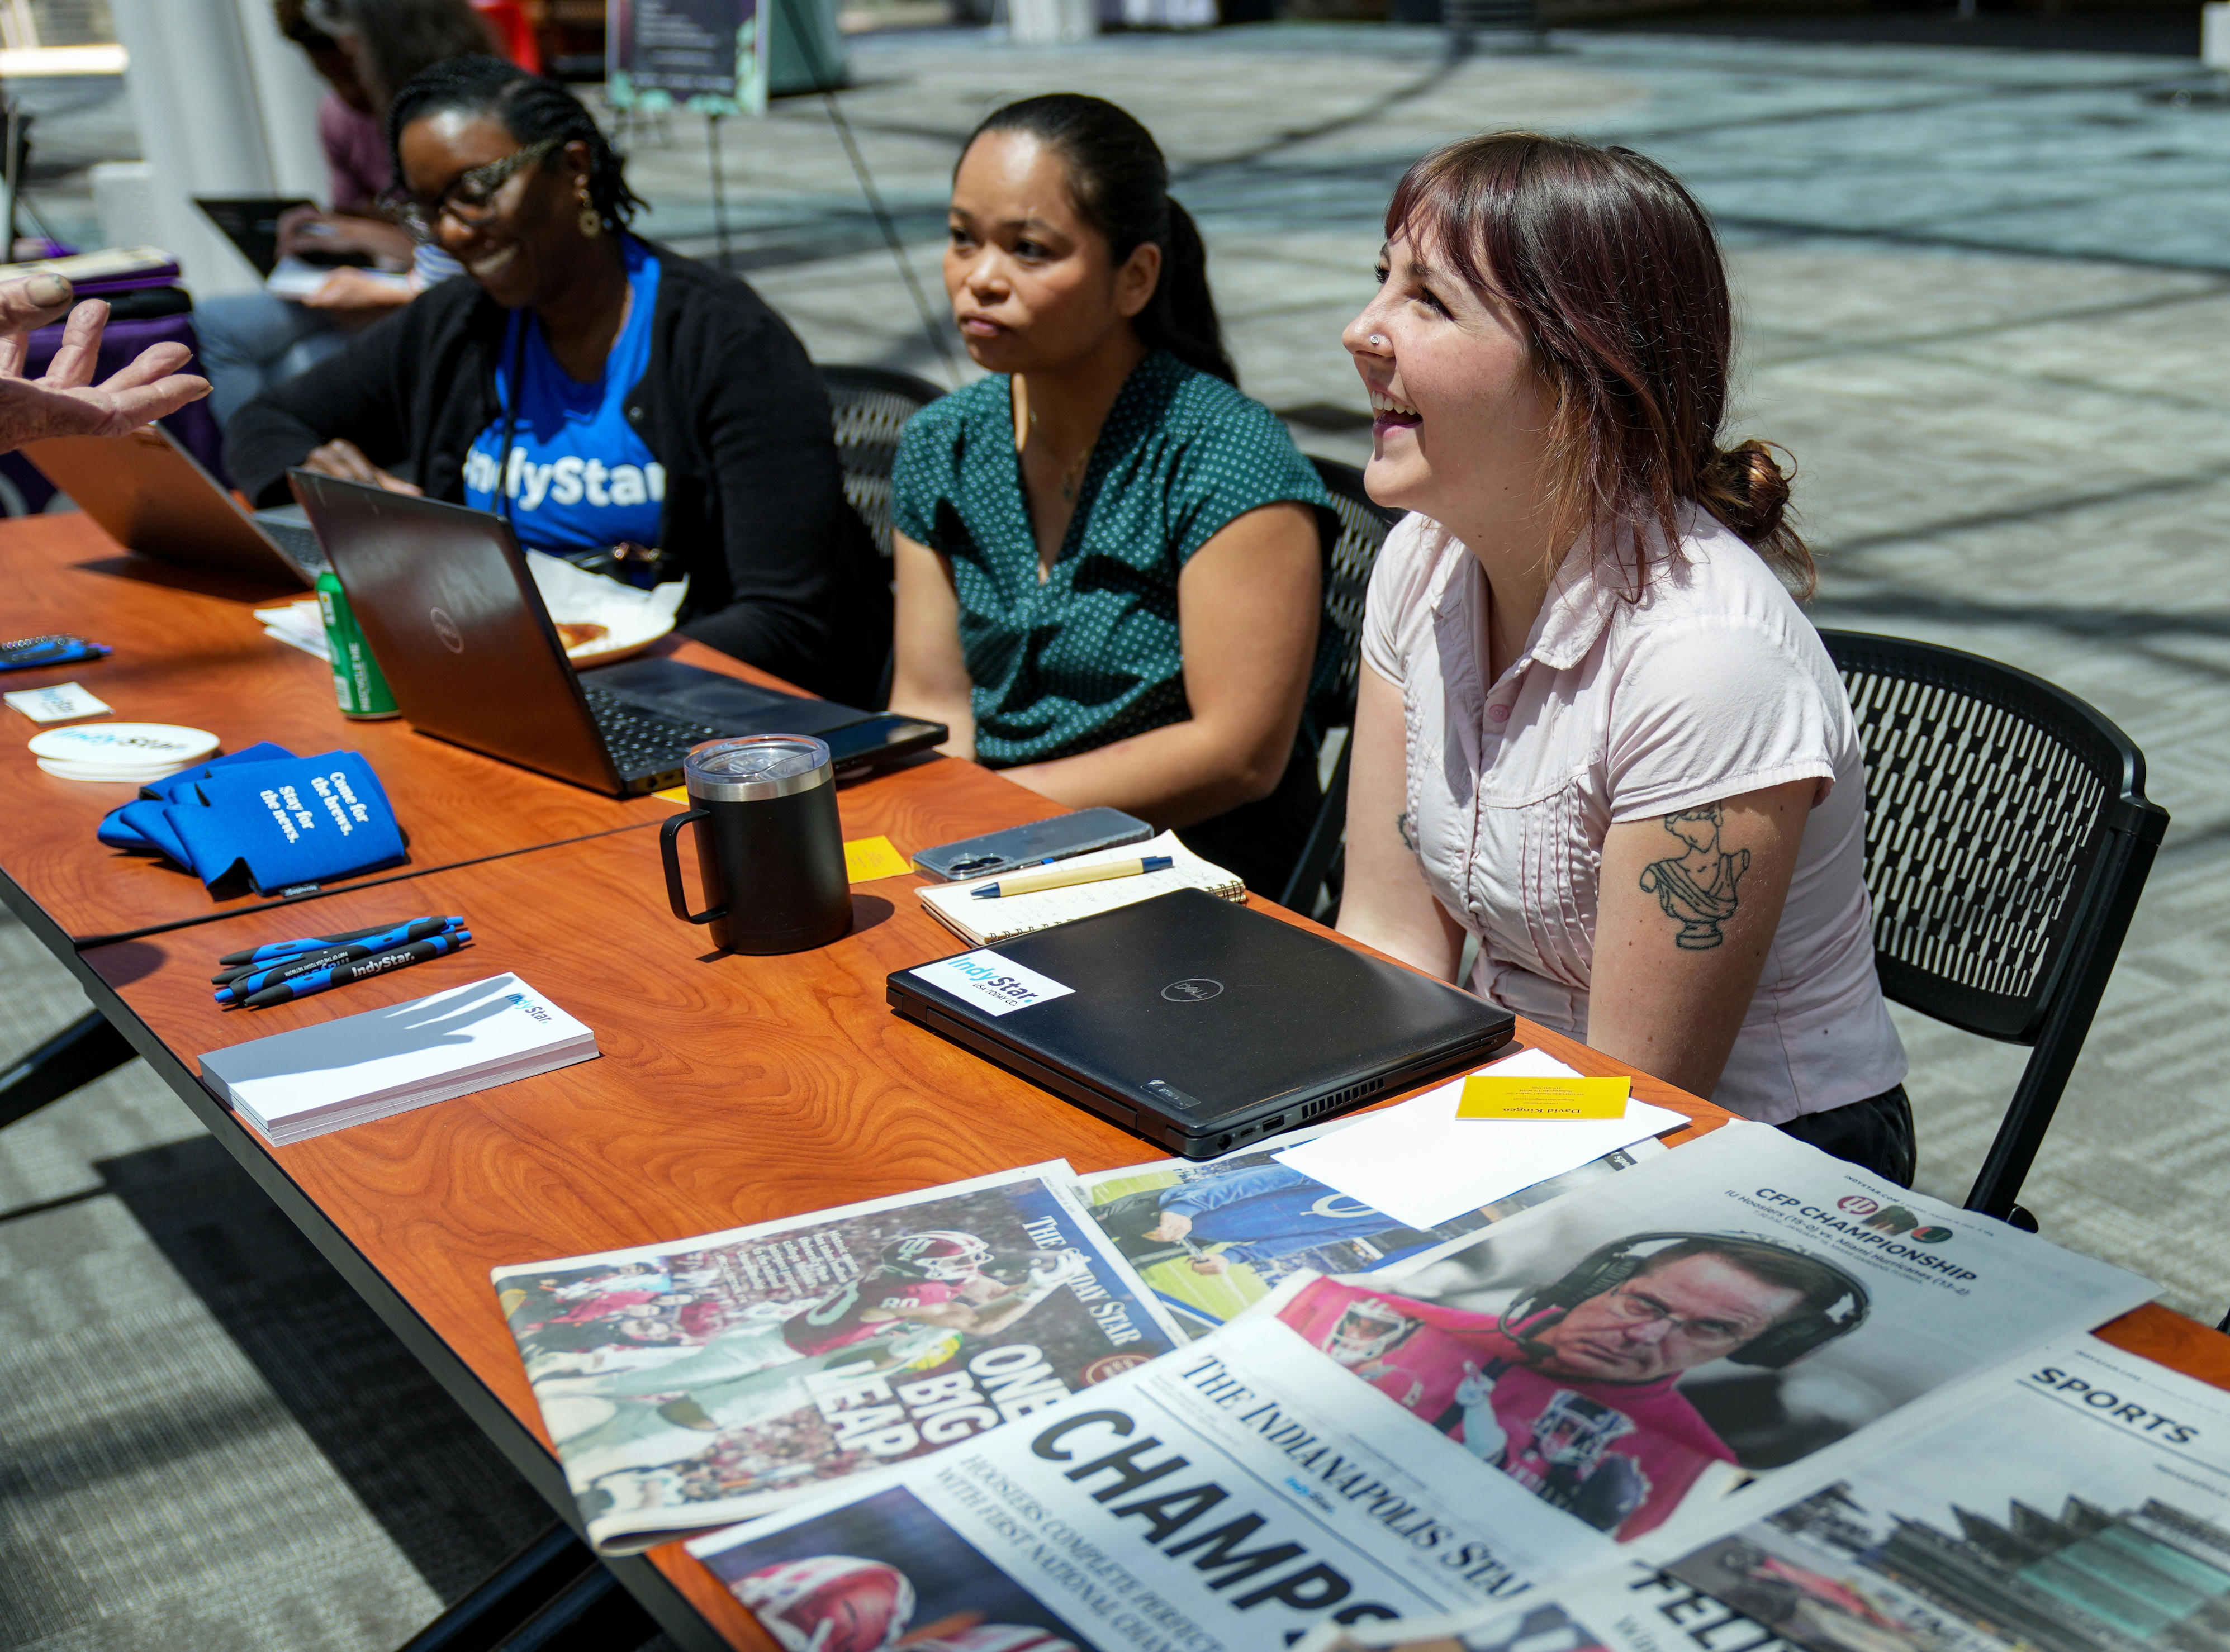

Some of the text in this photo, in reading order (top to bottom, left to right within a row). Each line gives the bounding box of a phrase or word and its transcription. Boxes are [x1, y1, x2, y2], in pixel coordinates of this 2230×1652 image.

[260, 789, 300, 844] the news.
[278, 785, 315, 829] Stay for
[311, 776, 353, 836] the brews.
[330, 771, 369, 823] Come for
[303, 960, 316, 969] TODAY
[351, 951, 416, 978] IndyStar.
[947, 957, 1040, 1004] IndyStar.
[972, 983, 1019, 1007] USA TODAY CO.
[1843, 1174, 1900, 1203] INDYSTAR.COM
[782, 1240, 801, 1263] college
[828, 1229, 850, 1254] Historic
[1725, 1189, 1971, 1295] IU Hoosiers (15-0) vs. Miami Hurricanes (13-2)
[1755, 1188, 1978, 1280] CFP CHAMPIONSHIP
[1021, 1215, 1067, 1250] THE
[1062, 1247, 1112, 1304] SDAY
[1089, 1301, 1142, 1347] STAR
[803, 1359, 921, 1458] LEAP
[896, 1369, 999, 1445] BIG
[968, 1344, 1072, 1423] ONE
[2030, 1366, 2200, 1444] SPORTS
[1180, 1354, 1256, 1412] THE
[1239, 1401, 1452, 1553] INDIANAPOLIS
[934, 1466, 989, 1508] WITH
[975, 1502, 1037, 1547] FIRST
[1022, 1543, 1123, 1618] NATIONAL
[959, 1454, 1054, 1522] HOOSIERS
[1040, 1517, 1144, 1594] COMPLETE
